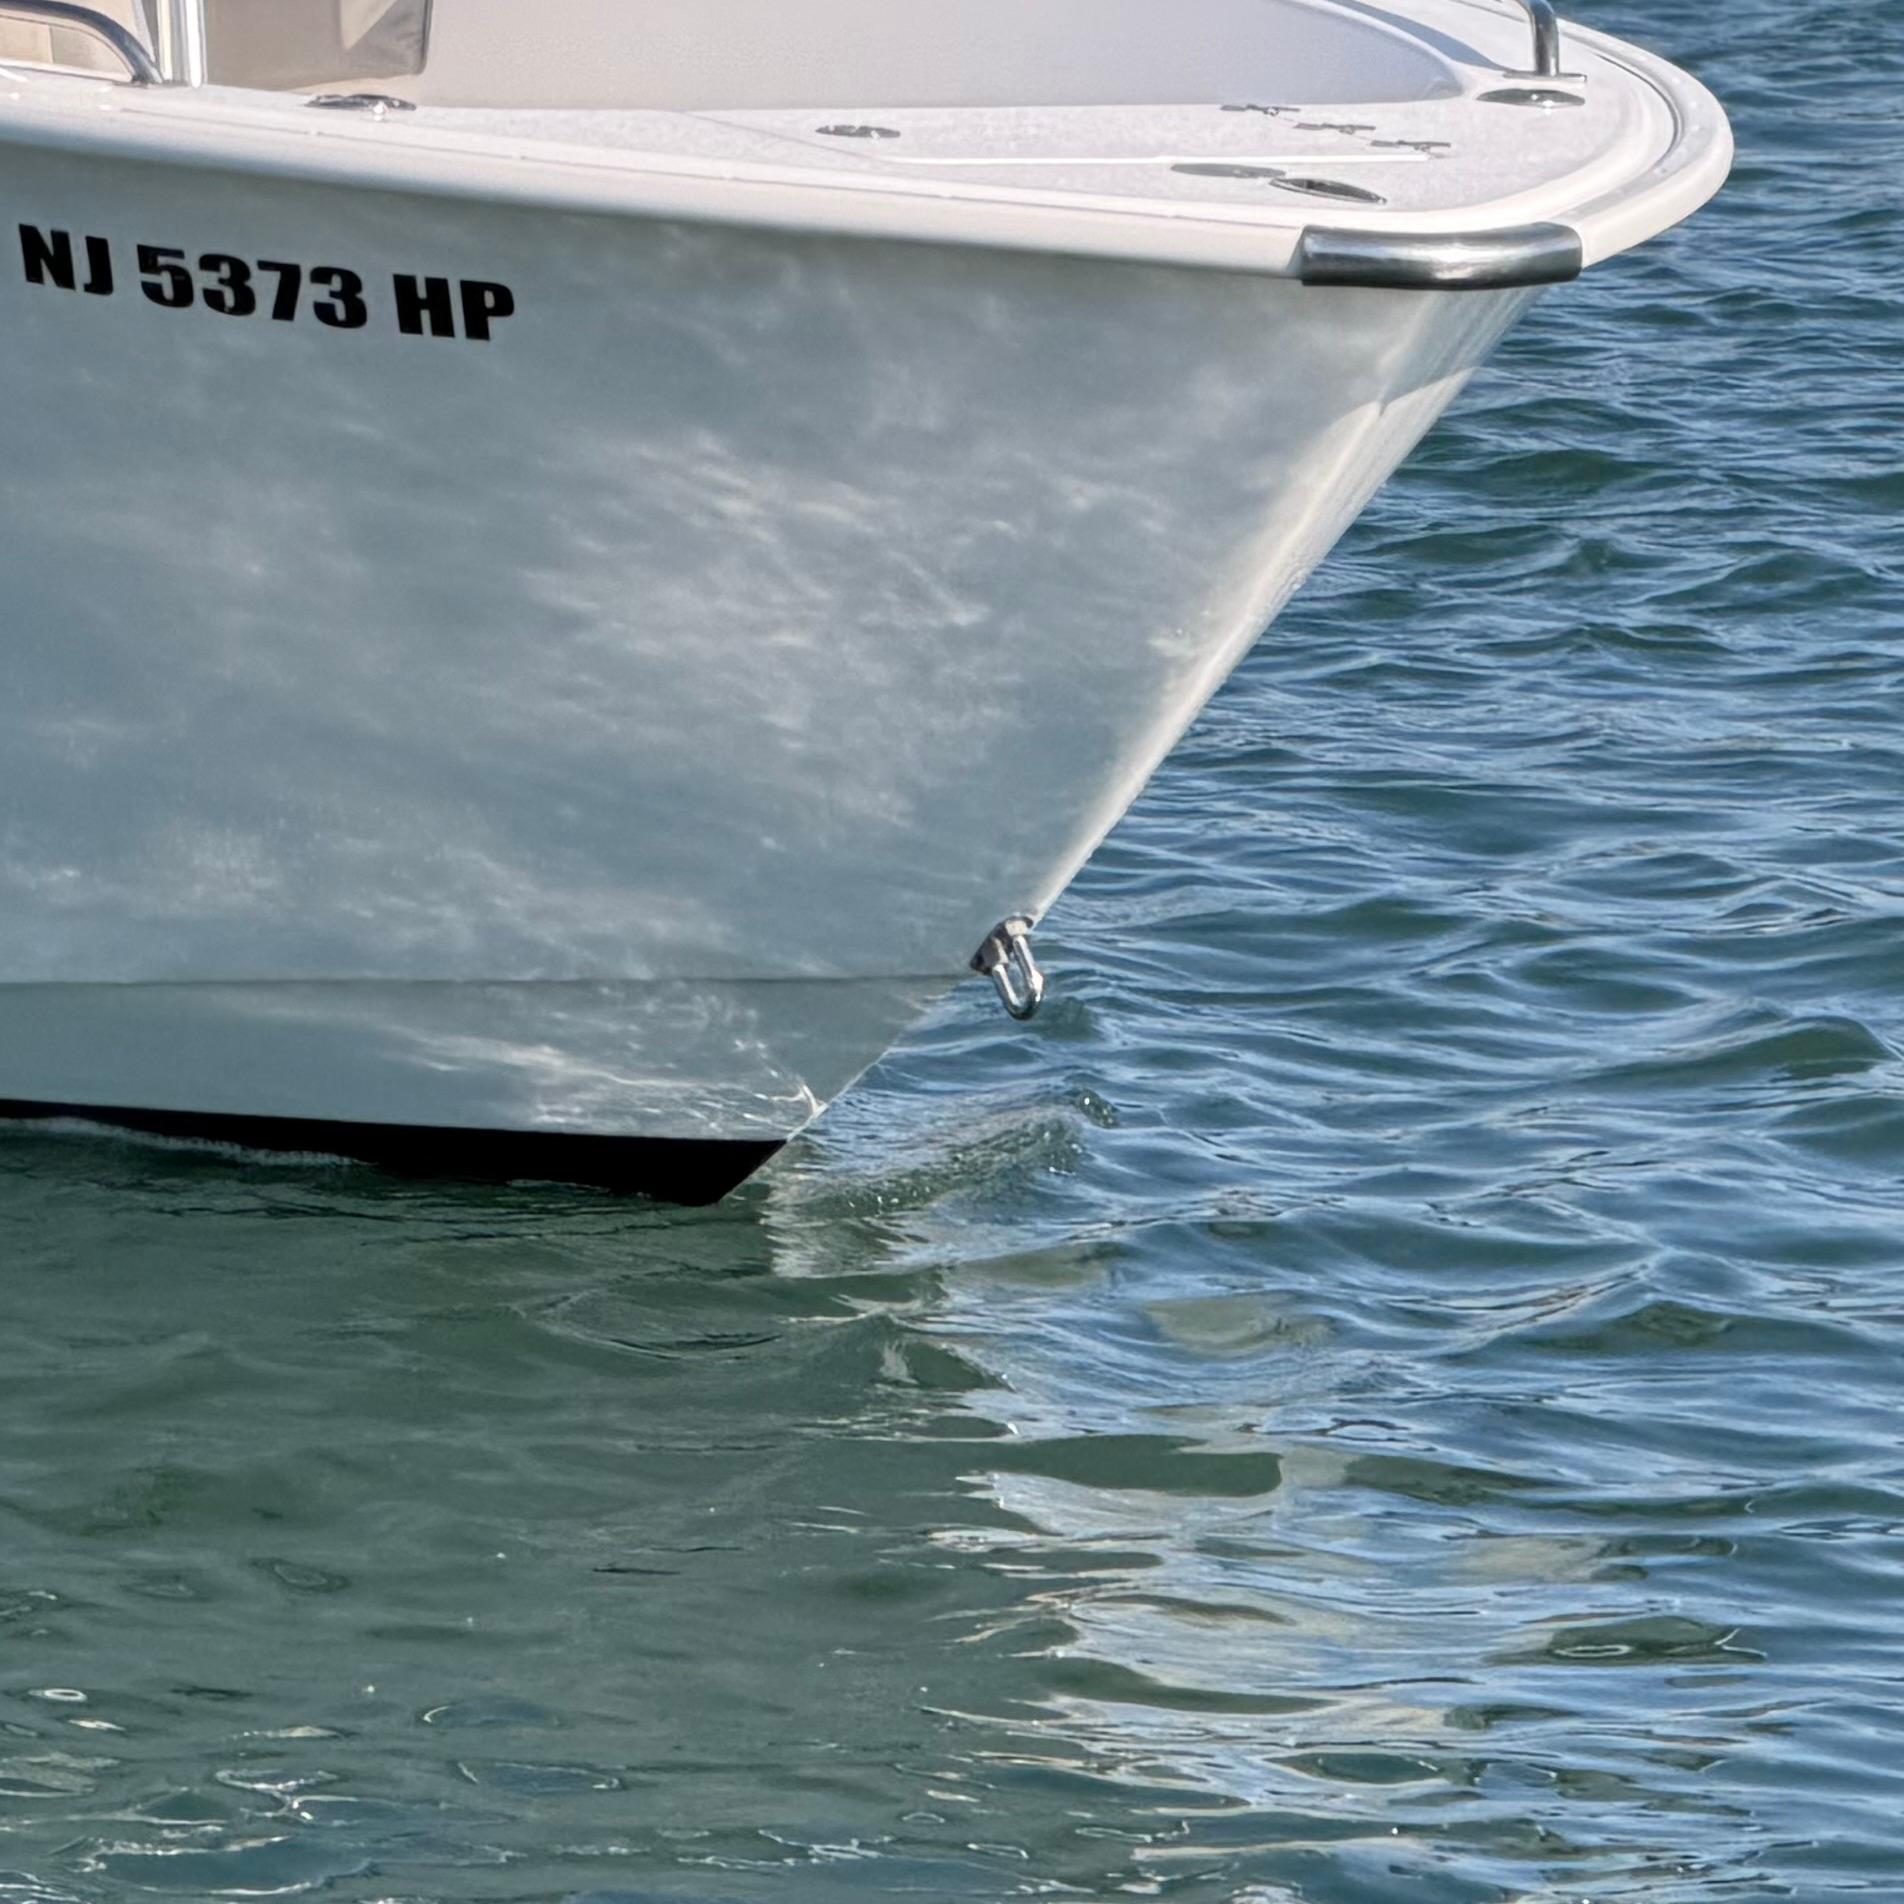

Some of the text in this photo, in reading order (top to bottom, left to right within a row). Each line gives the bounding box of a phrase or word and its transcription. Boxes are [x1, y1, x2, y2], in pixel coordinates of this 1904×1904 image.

[17, 223, 515, 341] NJ 5373 HP
